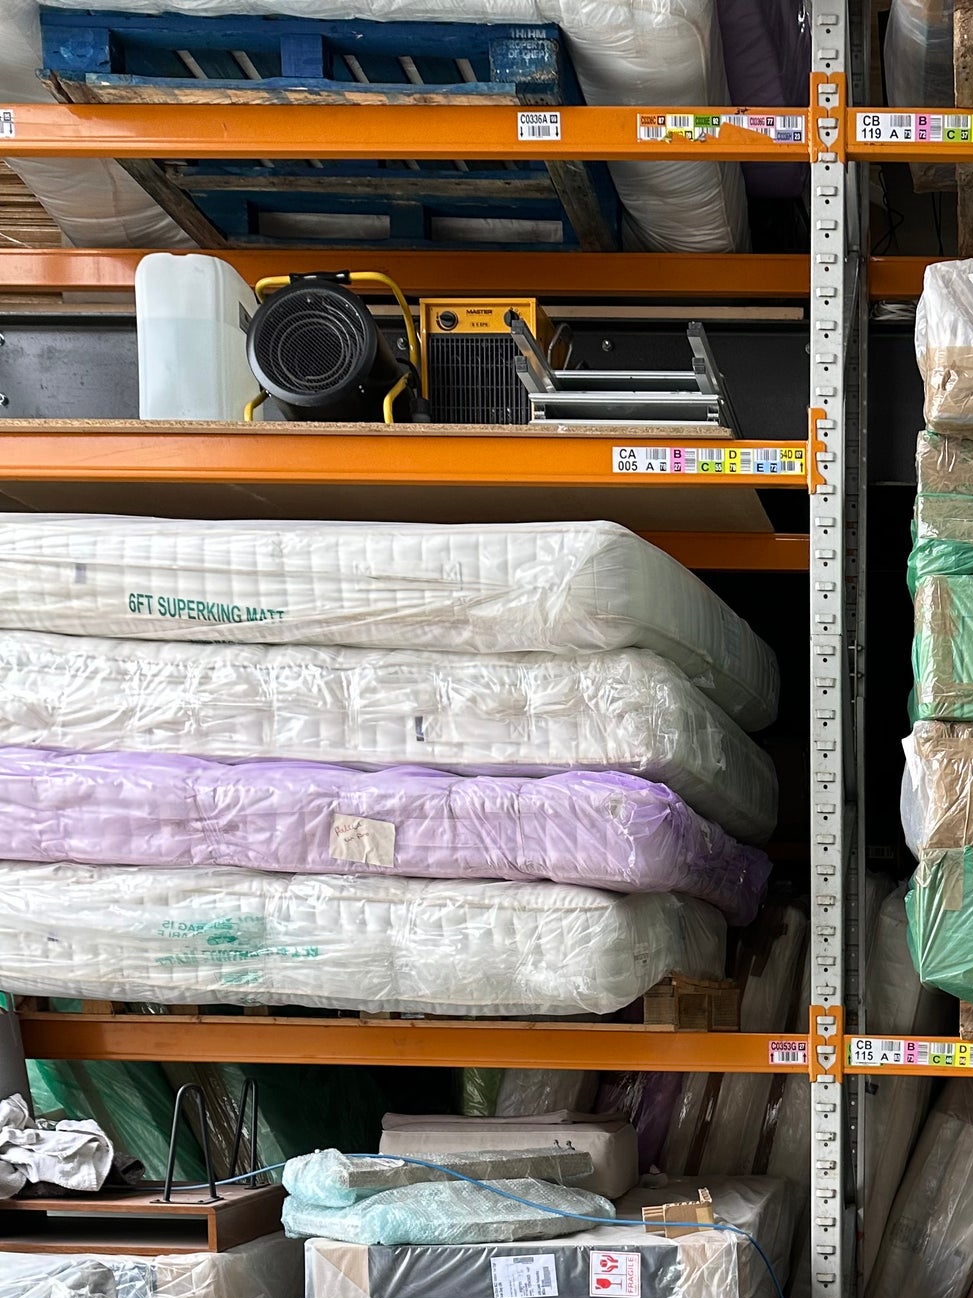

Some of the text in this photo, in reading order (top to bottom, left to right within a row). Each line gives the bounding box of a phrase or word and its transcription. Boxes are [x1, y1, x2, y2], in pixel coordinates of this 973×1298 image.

[520, 114, 548, 124] C0336A
[863, 115, 880, 126] CB
[919, 116, 927, 126] B
[861, 128, 882, 139] 119
[890, 130, 899, 139] A
[947, 130, 955, 139] C
[619, 449, 636, 459] CA
[674, 450, 682, 459] B
[729, 450, 737, 459] D
[618, 461, 638, 471] 005
[645, 463, 654, 471] A
[701, 463, 709, 472] C
[756, 463, 764, 472] E
[128, 593, 153, 614] 6FT
[157, 596, 242, 623] SUPERKING
[771, 1042, 796, 1050] C0353G
[856, 1040, 967, 1053] CB B D
[855, 1051, 873, 1061] 115
[881, 1053, 889, 1061] A
[933, 1055, 941, 1064] C
